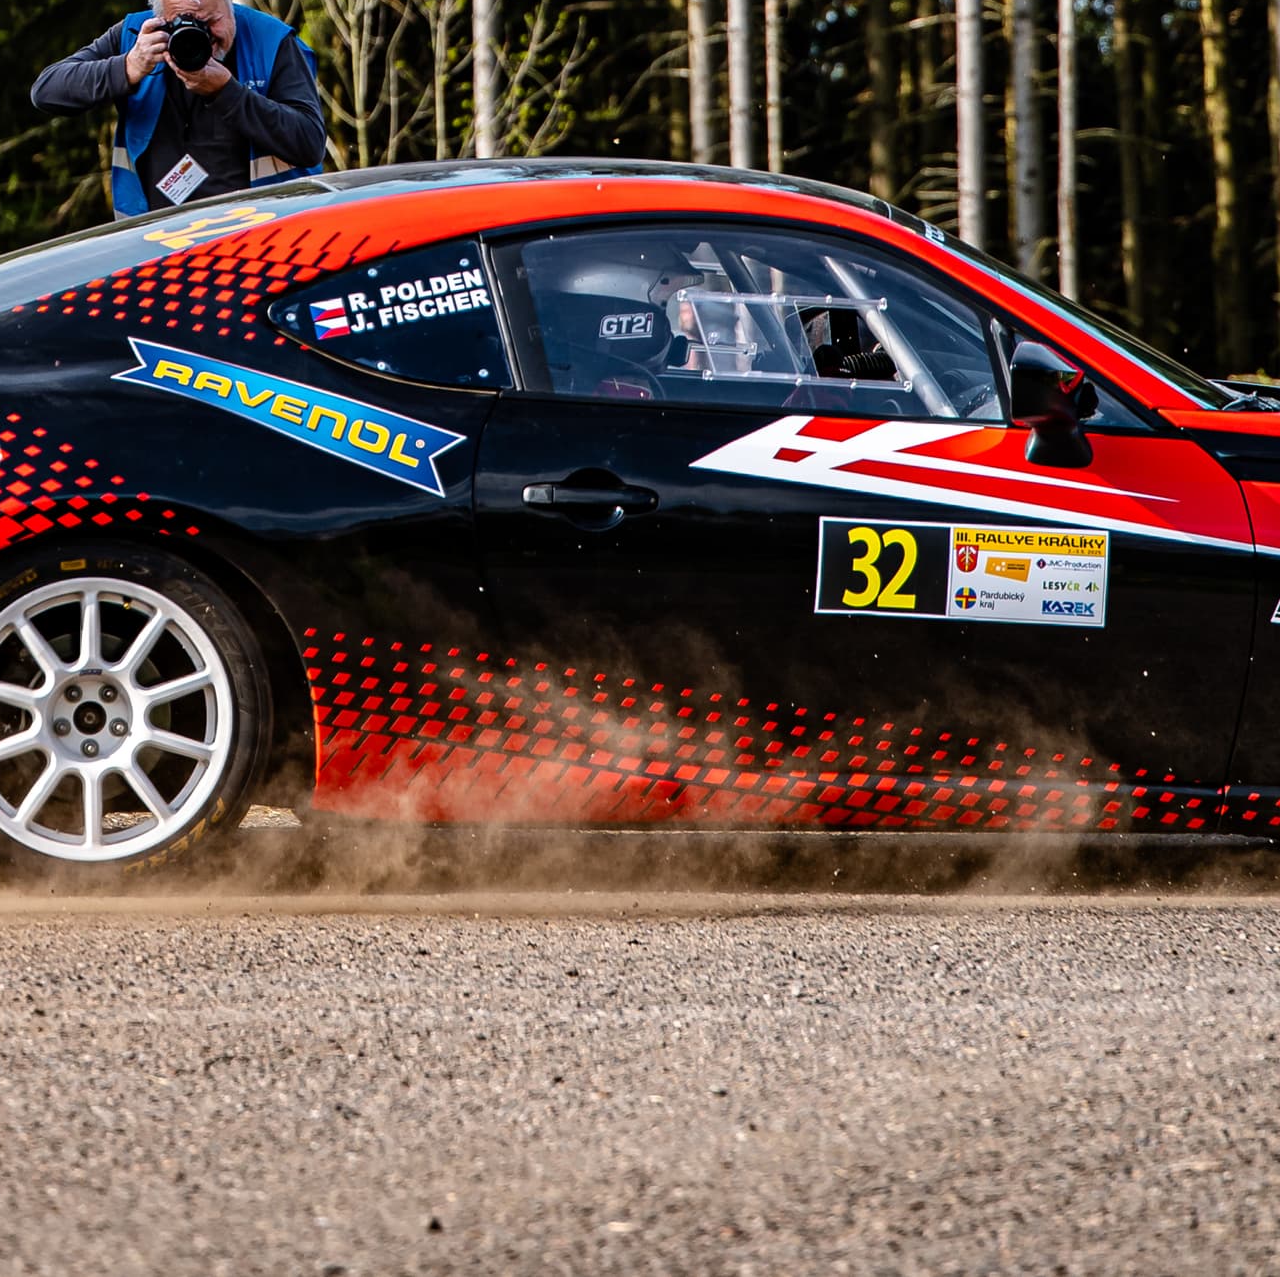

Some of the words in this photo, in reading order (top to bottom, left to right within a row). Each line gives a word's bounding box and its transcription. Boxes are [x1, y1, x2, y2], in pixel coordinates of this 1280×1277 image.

[347, 292, 376, 312] R.
[380, 269, 484, 305] POLDEN
[351, 313, 375, 332] J.
[378, 289, 491, 327] FISCHER
[601, 314, 652, 334] GT2i
[152, 359, 420, 468] RAVENOL
[956, 532, 972, 542] III.
[975, 533, 1034, 546] RALLYE
[1038, 535, 1105, 549] KRÁLÍKY
[842, 526, 918, 609] 32
[979, 600, 995, 610] kraj
[980, 590, 1025, 602] Pardubický
[1041, 600, 1095, 615] KAREK
